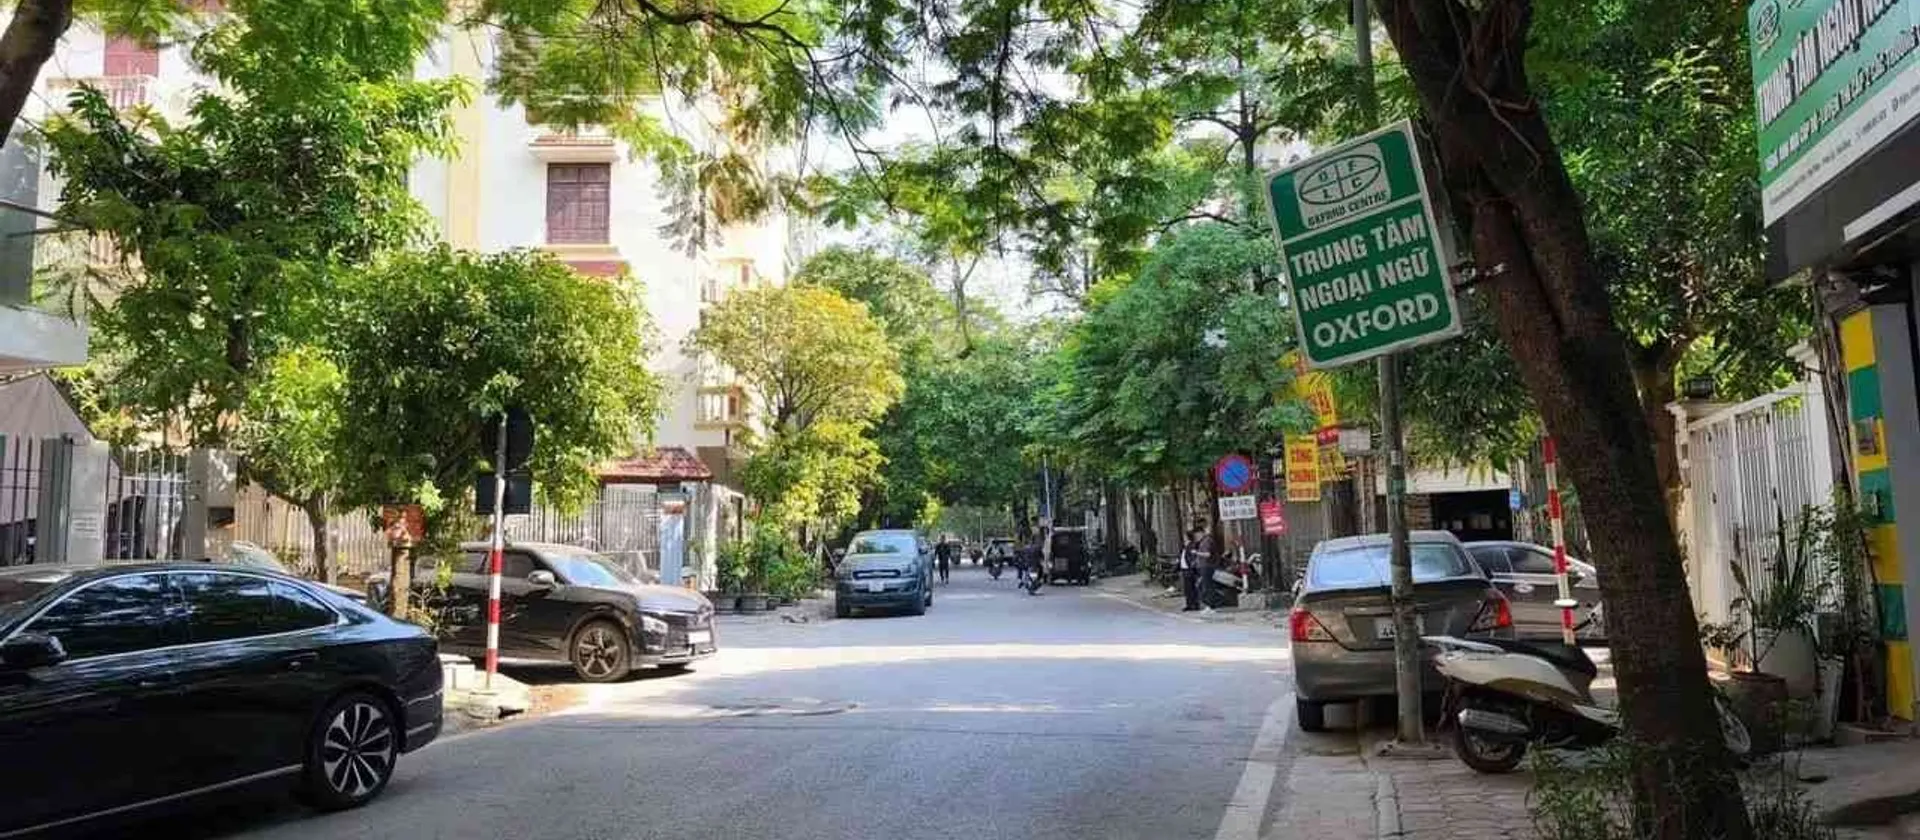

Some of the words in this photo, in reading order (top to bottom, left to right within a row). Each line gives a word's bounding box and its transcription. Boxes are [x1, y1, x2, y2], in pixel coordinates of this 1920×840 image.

[1757, 57, 1793, 131] TRUNG
[1308, 204, 1347, 227] OXFORD
[1347, 191, 1388, 212] CENTRE
[1291, 234, 1368, 277] TRUNG
[1370, 214, 1427, 251] TÂM
[1300, 269, 1373, 312] NGOẠI
[1376, 247, 1430, 289] NGỮ
[1313, 292, 1440, 348] OXFORD
